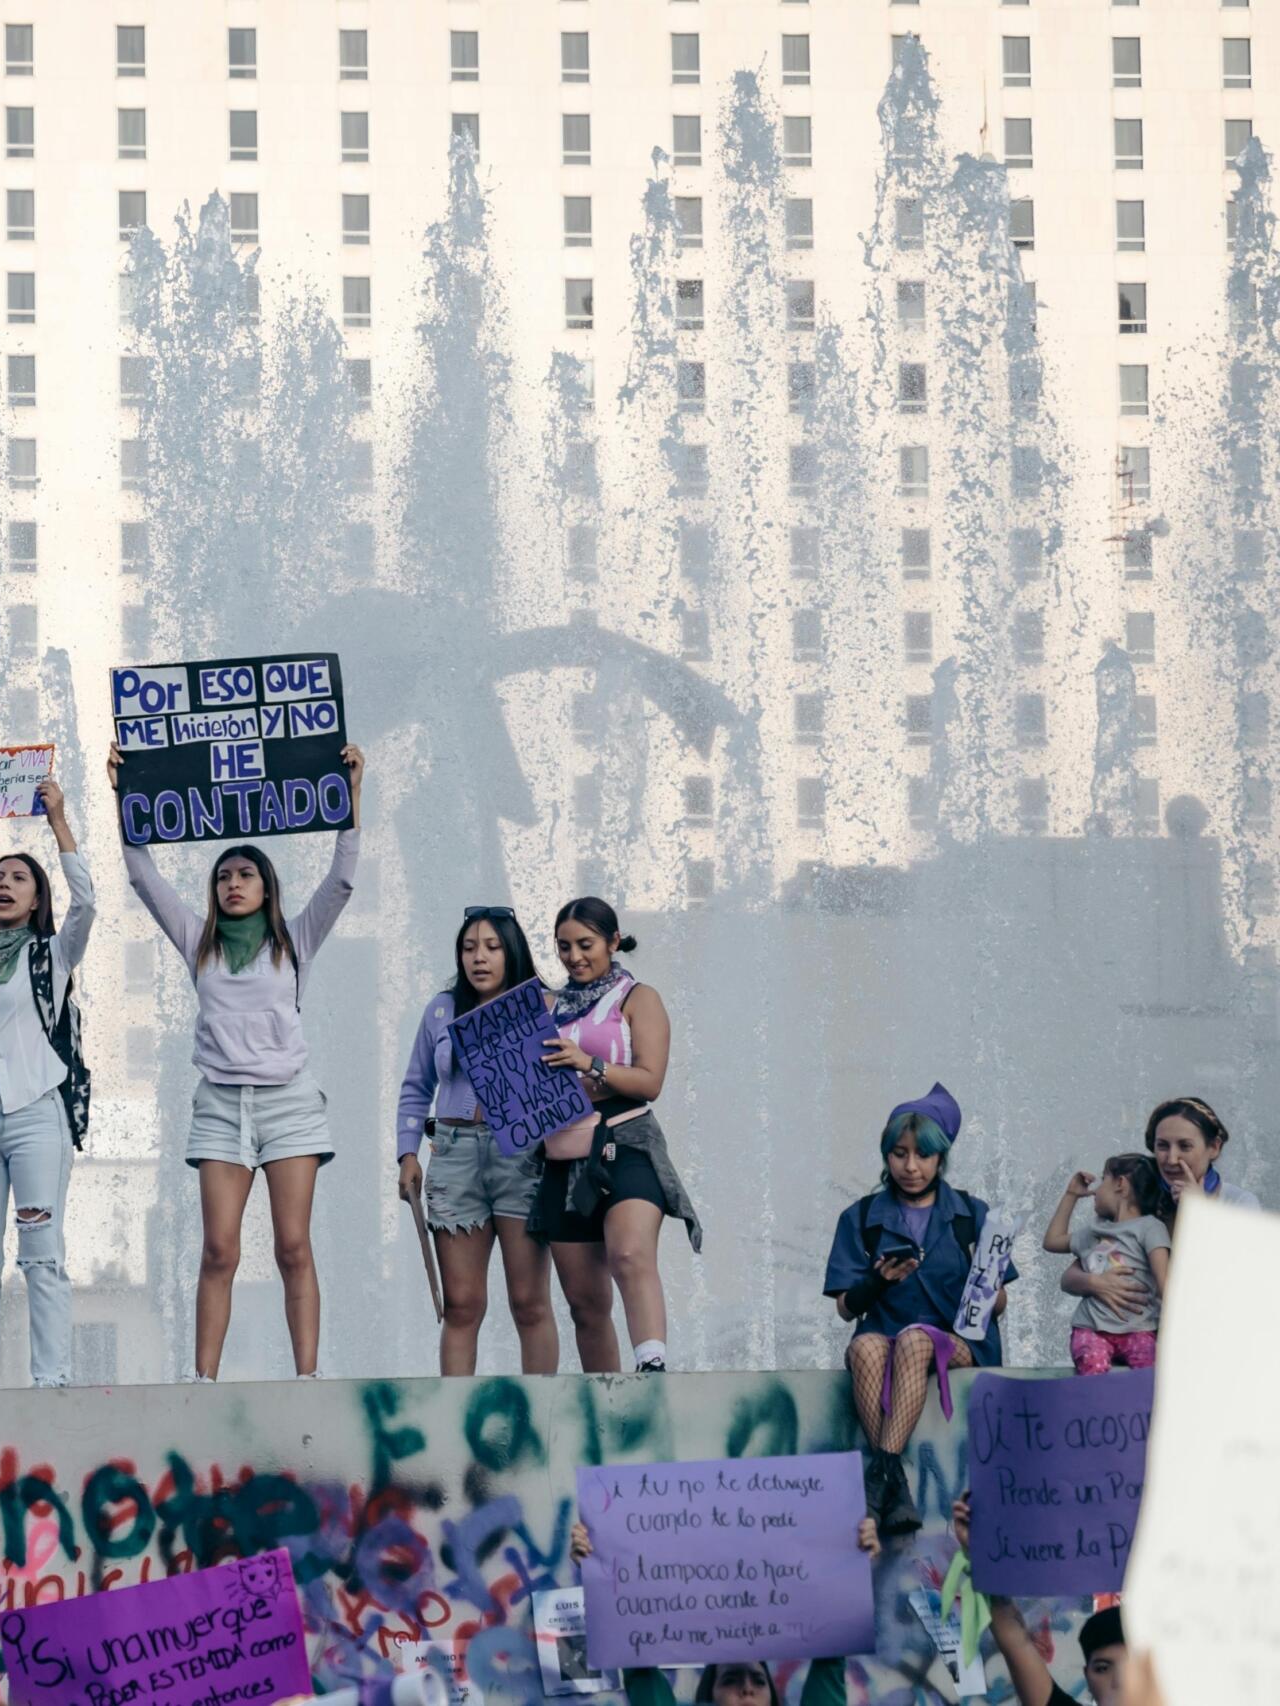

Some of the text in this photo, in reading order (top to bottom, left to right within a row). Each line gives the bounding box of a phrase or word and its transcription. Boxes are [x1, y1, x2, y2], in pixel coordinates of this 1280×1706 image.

[201, 667, 254, 702] ESO
[265, 660, 330, 694] QUE
[120, 718, 165, 746] ME
[173, 713, 256, 742] hicieron
[290, 702, 336, 736] NO
[27, 774, 49, 783] ser
[213, 743, 263, 780] HE
[122, 772, 351, 845] CONTADO
[454, 984, 541, 1048] MARCHO
[467, 1042, 528, 1091] ESTOY
[475, 1073, 517, 1109] VIVA
[488, 1071, 577, 1131] SE HASTA
[511, 1091, 585, 1148] CUANDO
[974, 1392, 1010, 1465] Si
[1014, 1398, 1053, 1450] te
[639, 1473, 668, 1497] tu
[679, 1480, 705, 1502] no
[717, 1470, 740, 1491] te
[995, 1466, 1061, 1506] Prende
[1075, 1485, 1102, 1504] un
[626, 1508, 702, 1535] cuando
[712, 1506, 730, 1527] te
[738, 1507, 755, 1527] lo
[988, 1526, 1015, 1563] Si
[1021, 1543, 1066, 1561] viene
[1076, 1528, 1100, 1558] la
[638, 1554, 729, 1584] tampoco
[735, 1558, 758, 1581] lo
[555, 1601, 579, 1611] LUIS
[616, 1589, 789, 1616] cuando cuente lo
[629, 1630, 657, 1656] que
[662, 1623, 683, 1642] tu
[688, 1630, 713, 1646] me
[768, 1623, 780, 1635] a
[31, 1637, 75, 1688] Si
[150, 1669, 175, 1692] ES
[172, 1643, 246, 1681] TEMIDA
[250, 1632, 297, 1659] como
